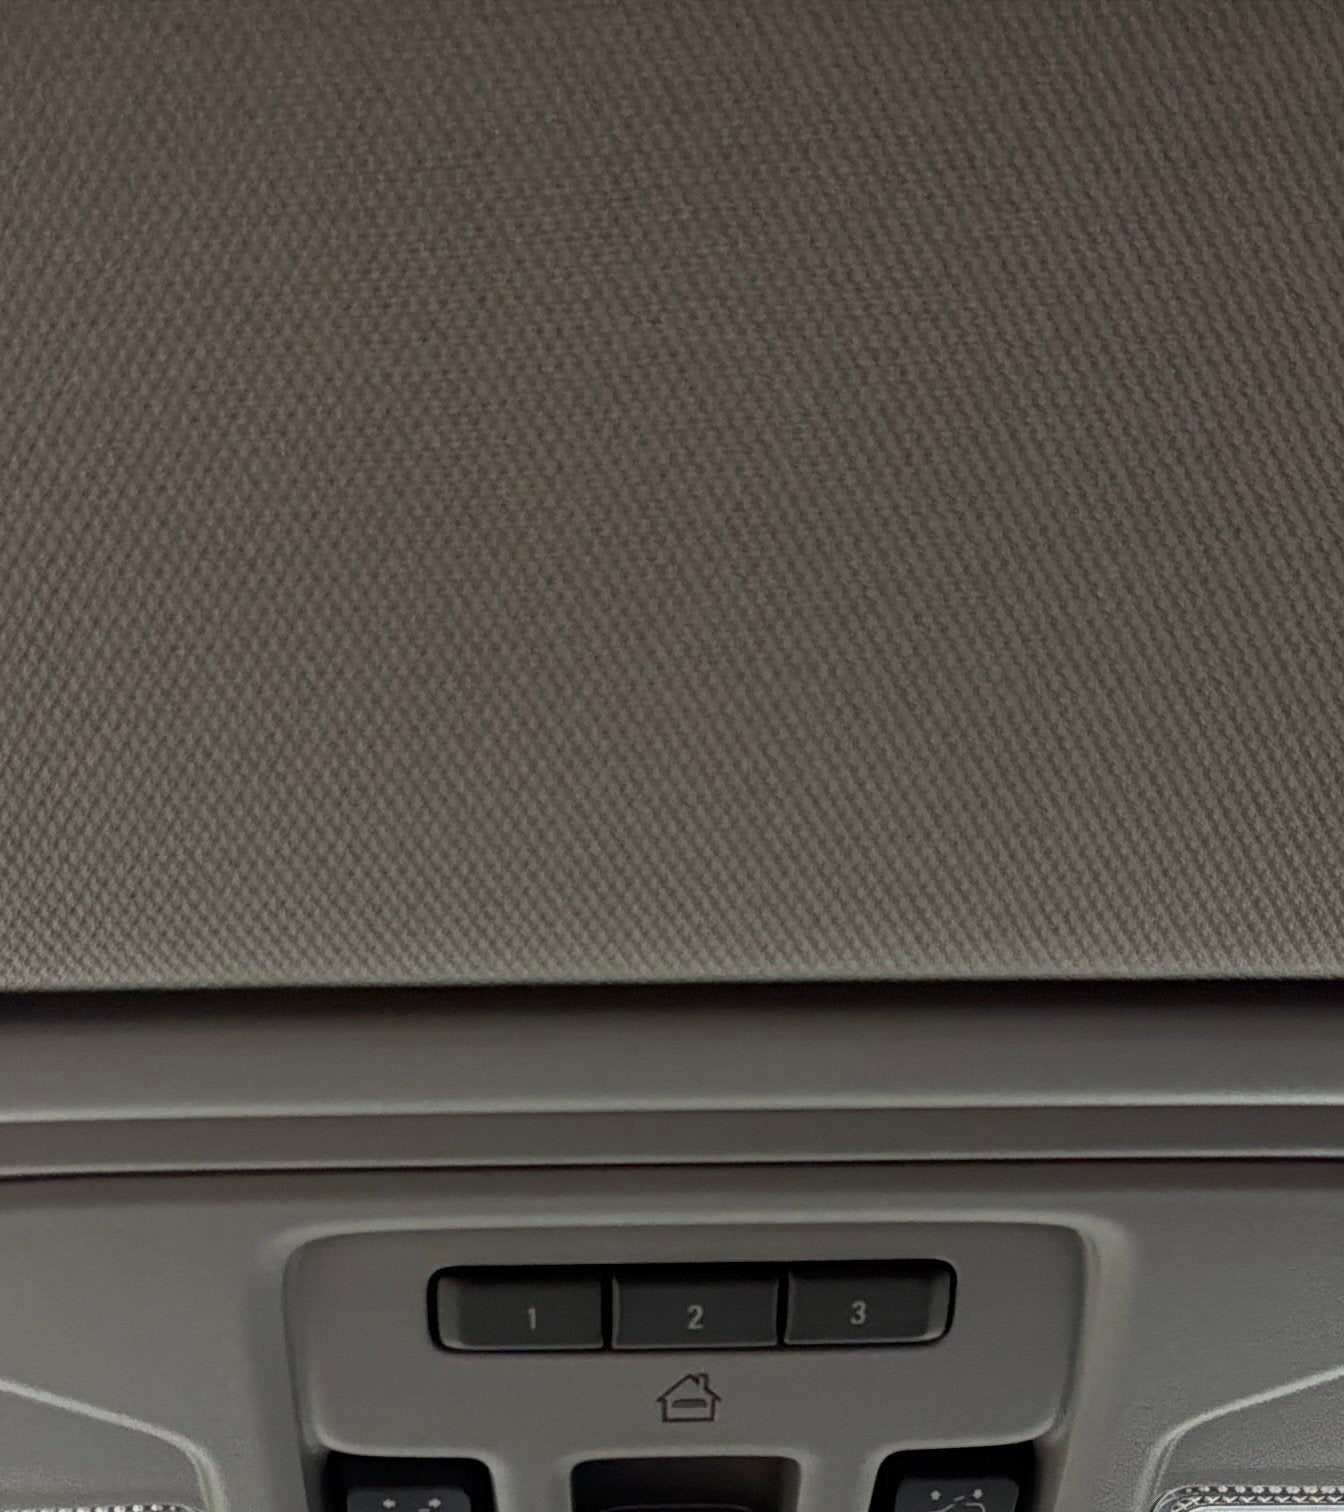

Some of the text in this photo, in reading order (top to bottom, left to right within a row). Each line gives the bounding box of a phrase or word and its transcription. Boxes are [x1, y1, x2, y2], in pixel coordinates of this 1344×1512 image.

[526, 1307, 538, 1331] 1
[686, 1304, 705, 1331] 2
[850, 1300, 868, 1326] 3
